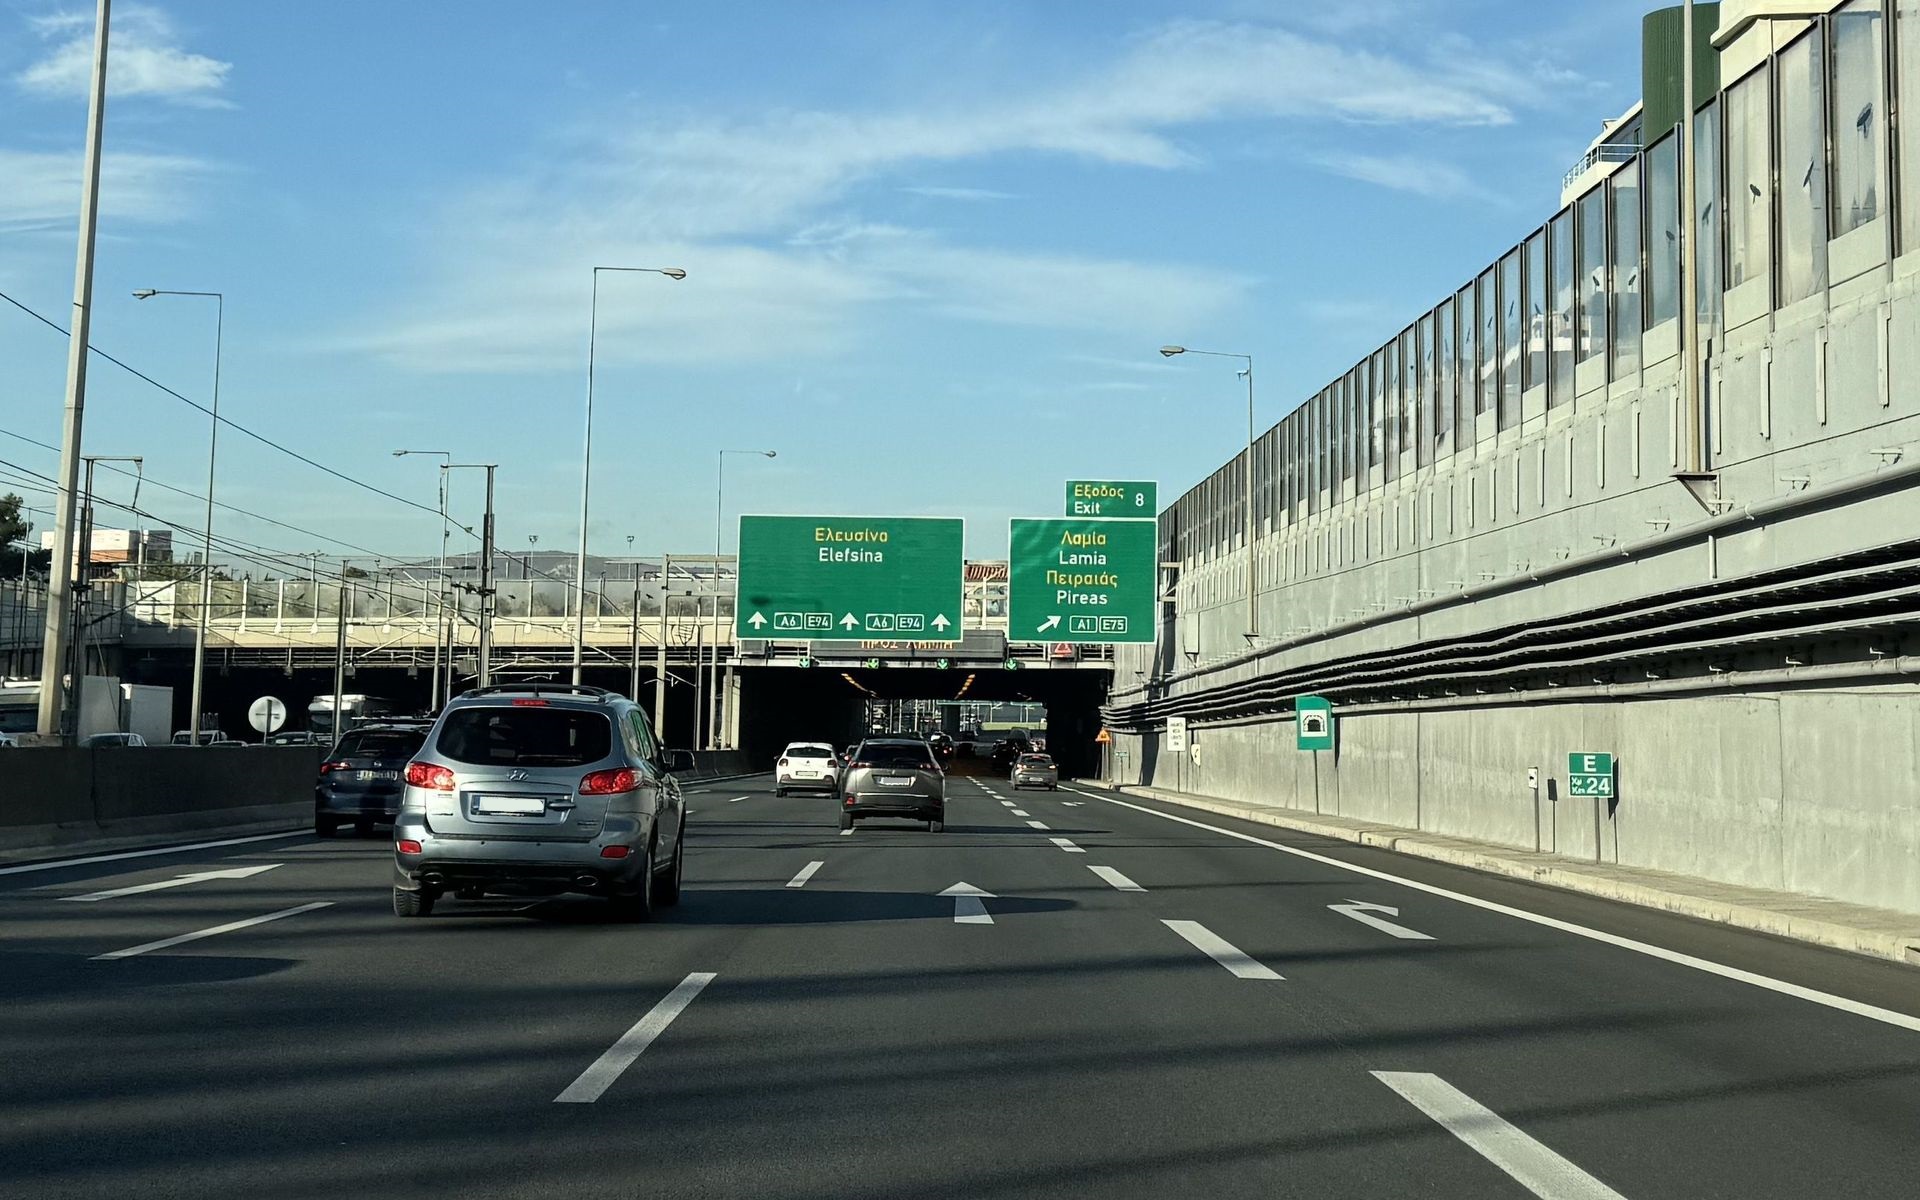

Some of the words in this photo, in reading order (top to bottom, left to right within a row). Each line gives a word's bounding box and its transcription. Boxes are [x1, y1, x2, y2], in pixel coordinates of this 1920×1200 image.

[1075, 484, 1124, 499] Εξοδος
[1135, 493, 1145, 507] 8
[1075, 501, 1101, 515] Exit
[815, 527, 888, 543] Ελευσίνα
[1060, 530, 1106, 548] Λαμία
[819, 548, 883, 563] Elefsina
[1060, 550, 1107, 565] Lamia
[1046, 569, 1118, 588] Πειραιάς
[1057, 589, 1108, 605] Pireas
[780, 615, 796, 627] A6
[808, 615, 829, 628] E94
[872, 615, 889, 628] A6
[899, 615, 921, 629] E94
[1077, 618, 1090, 630] A1
[1103, 618, 1125, 631] E75
[1586, 777, 1610, 794] 24
